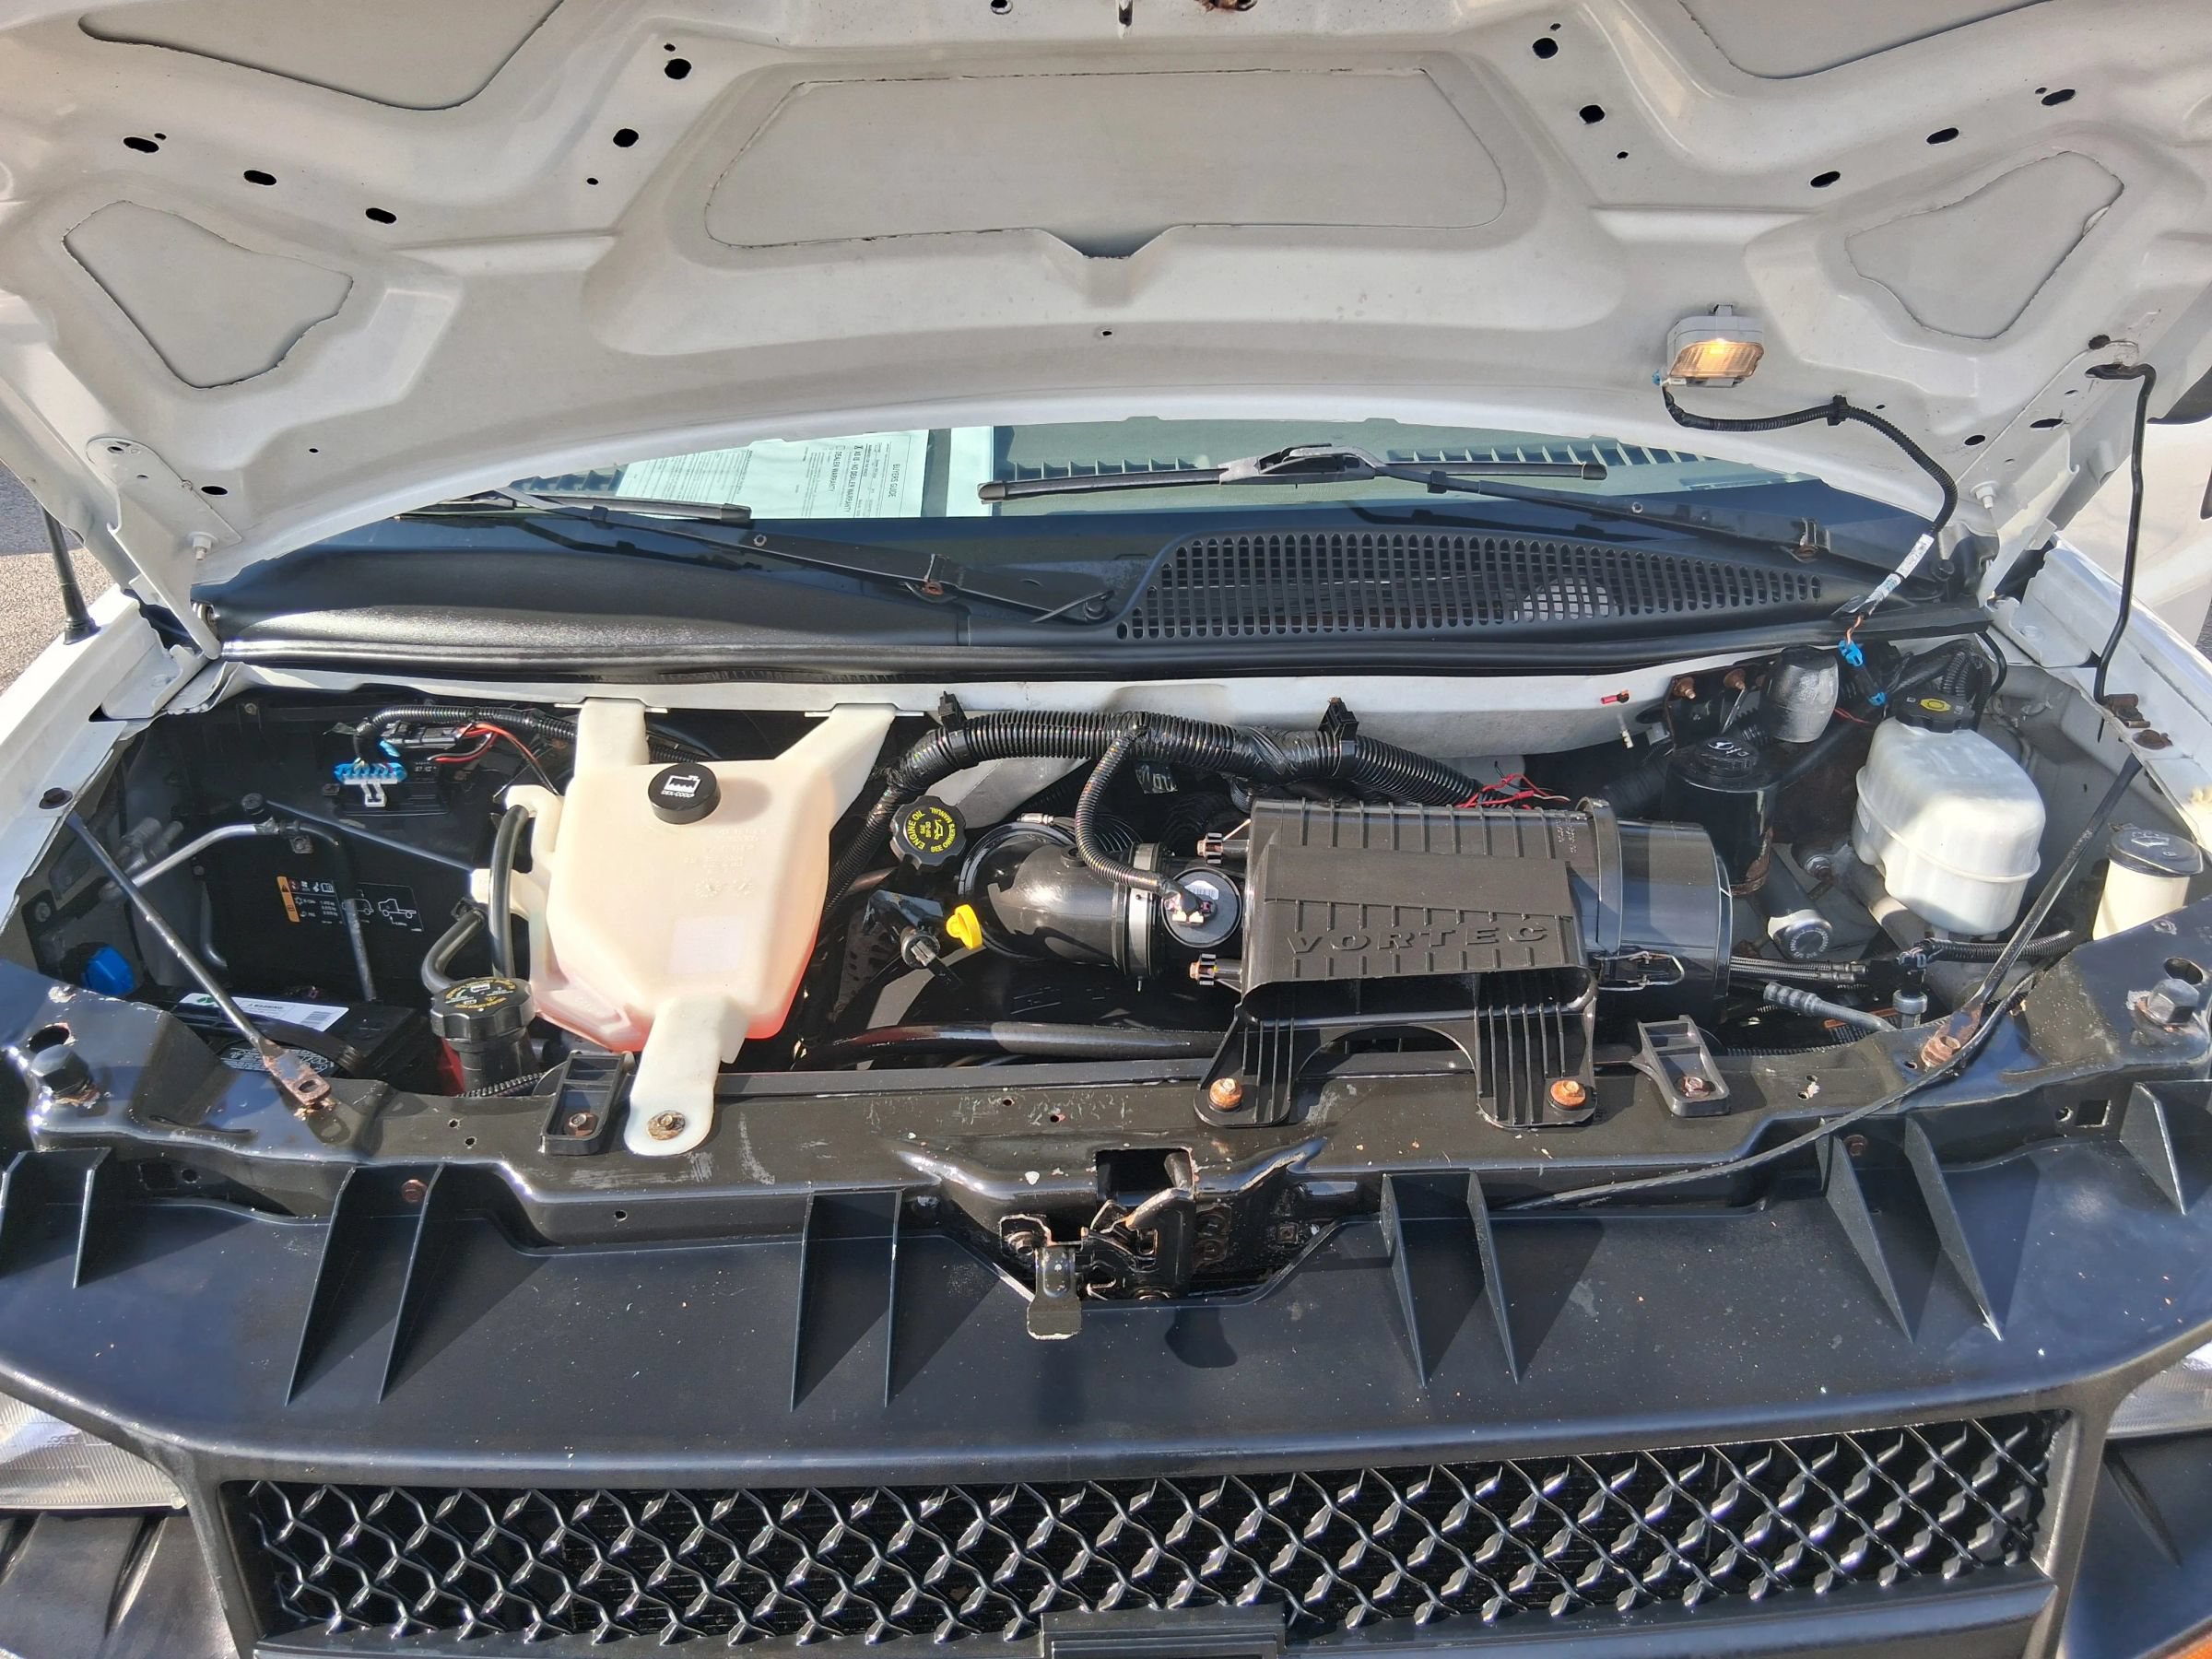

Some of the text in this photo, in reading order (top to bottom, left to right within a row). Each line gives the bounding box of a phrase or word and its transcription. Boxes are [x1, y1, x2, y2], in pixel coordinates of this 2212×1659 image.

[829, 451, 842, 492] DEALER WARRANTY
[848, 471, 858, 488] DEALER
[888, 464, 900, 498] BUYERS GUIDE
[843, 488, 854, 512] WARRANTY
[929, 806, 953, 824] MANUAL
[908, 810, 926, 850] ENGINE OIL
[1287, 925, 1548, 954] VORTEC
